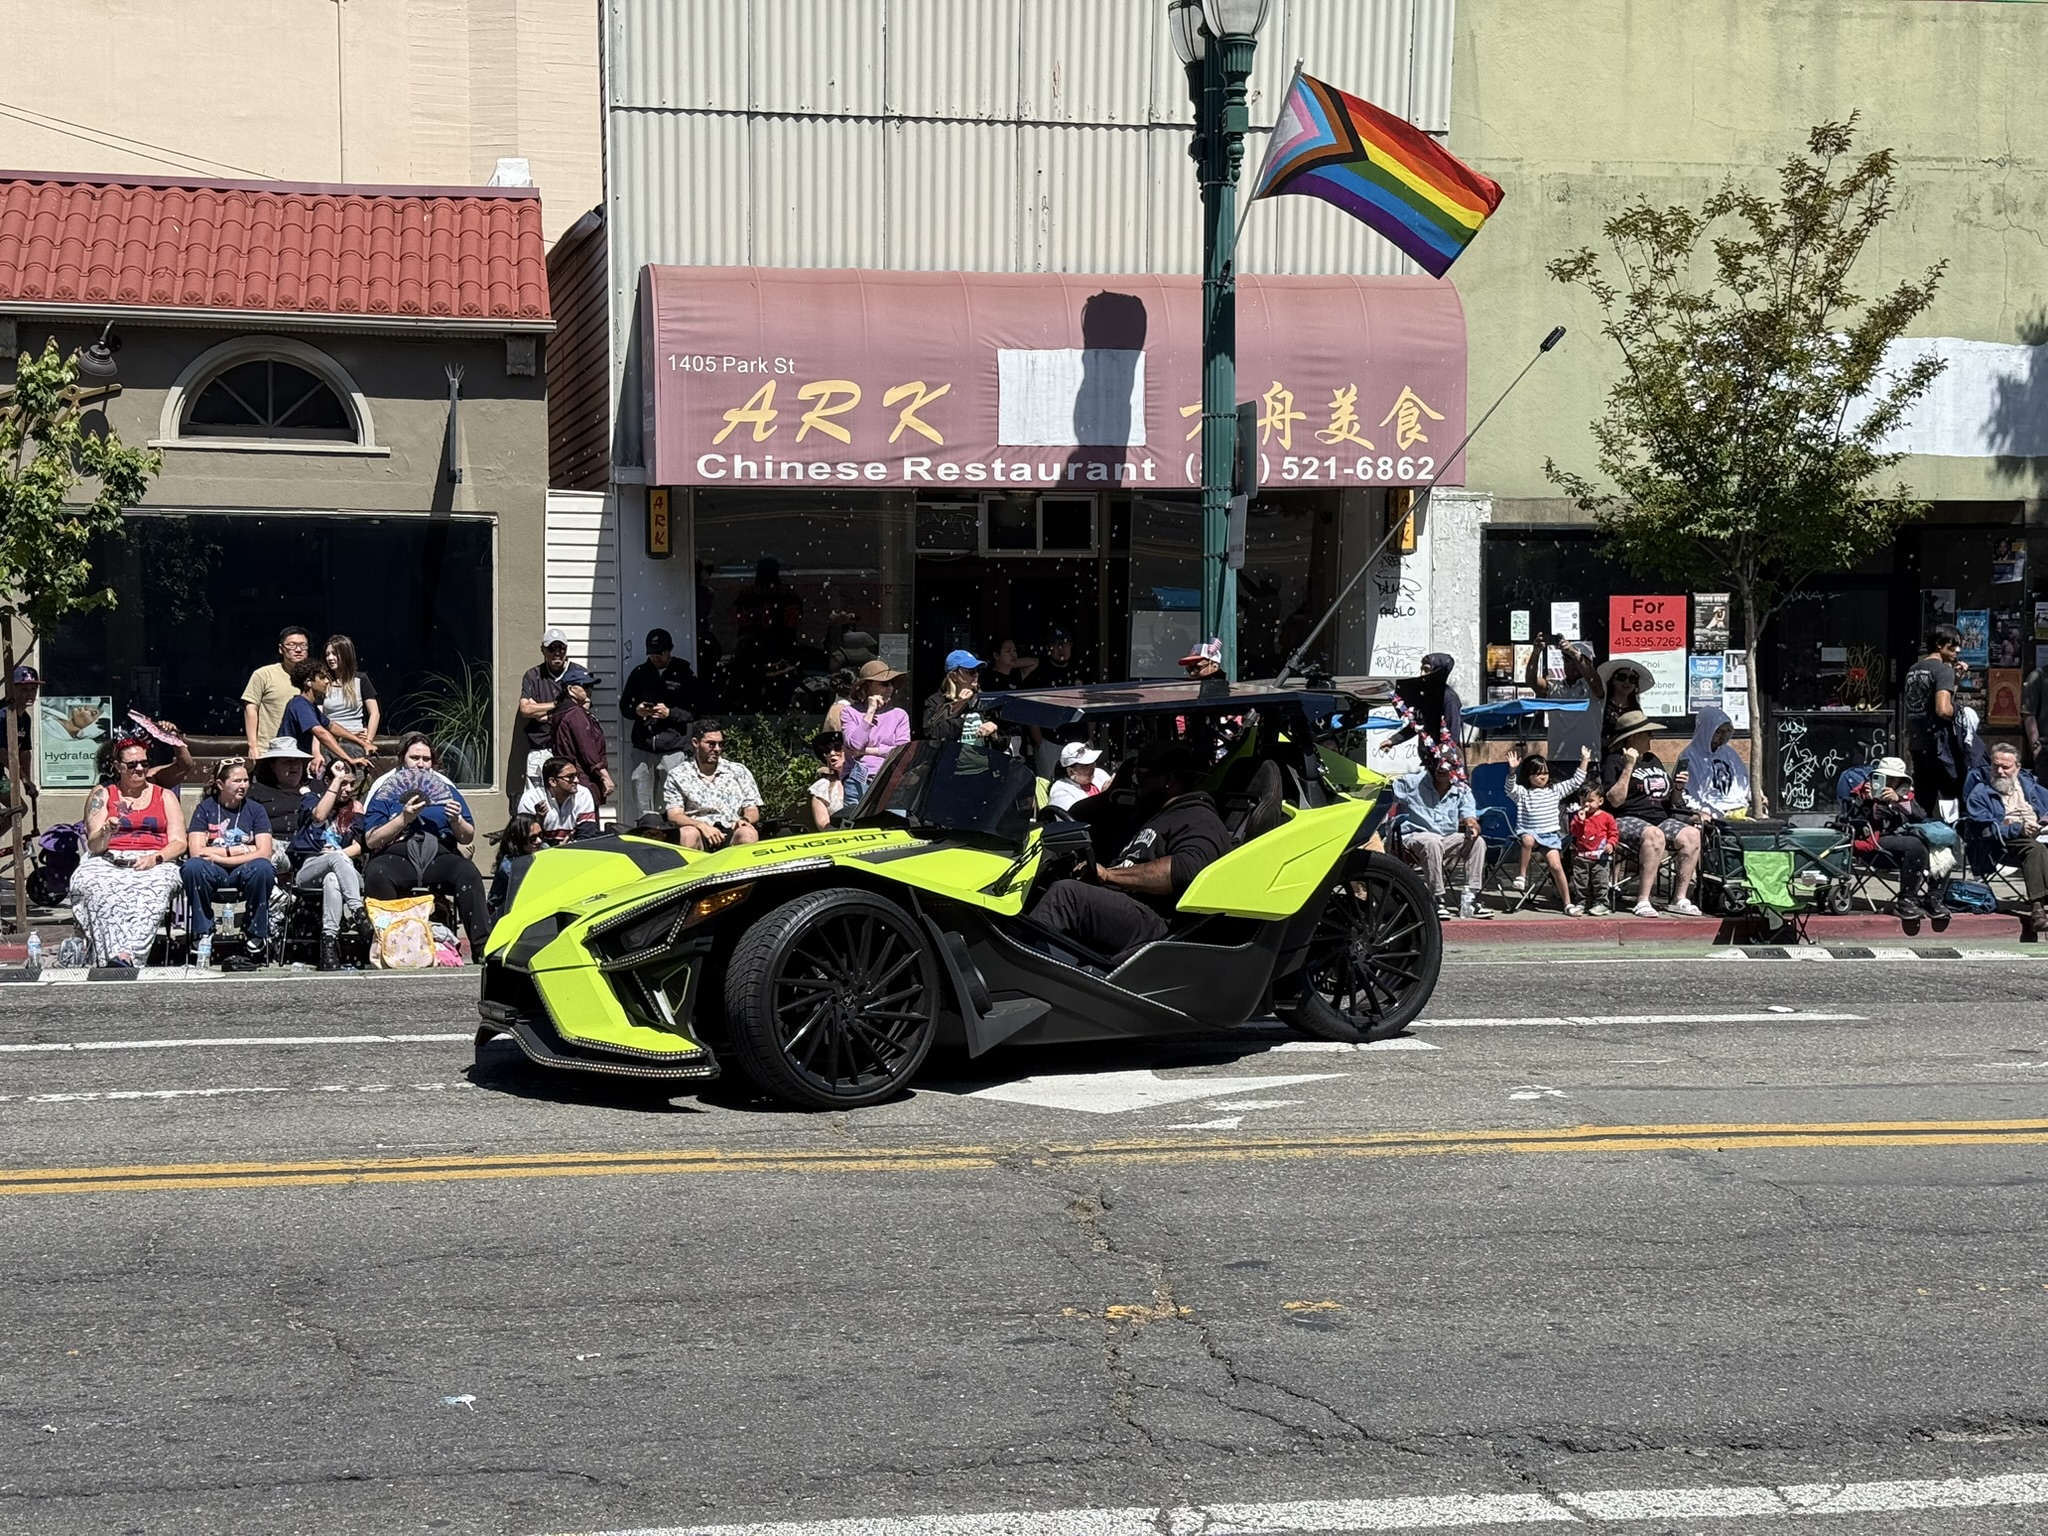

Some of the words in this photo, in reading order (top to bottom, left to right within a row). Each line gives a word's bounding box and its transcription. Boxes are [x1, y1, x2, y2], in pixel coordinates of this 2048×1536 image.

[668, 354, 717, 372] 1405
[723, 356, 769, 373] Park
[774, 357, 796, 374] St
[712, 379, 951, 445] ARK
[696, 453, 887, 480] Chinese
[903, 456, 1156, 482] Restaurant
[1281, 455, 1435, 481] 521-6862
[1632, 599, 1664, 614] For
[1621, 617, 1675, 632] Lease
[1614, 637, 1682, 647] 415.395.7262
[45, 752, 96, 761] Hydrafac
[752, 833, 892, 857] SLINGSHOT
